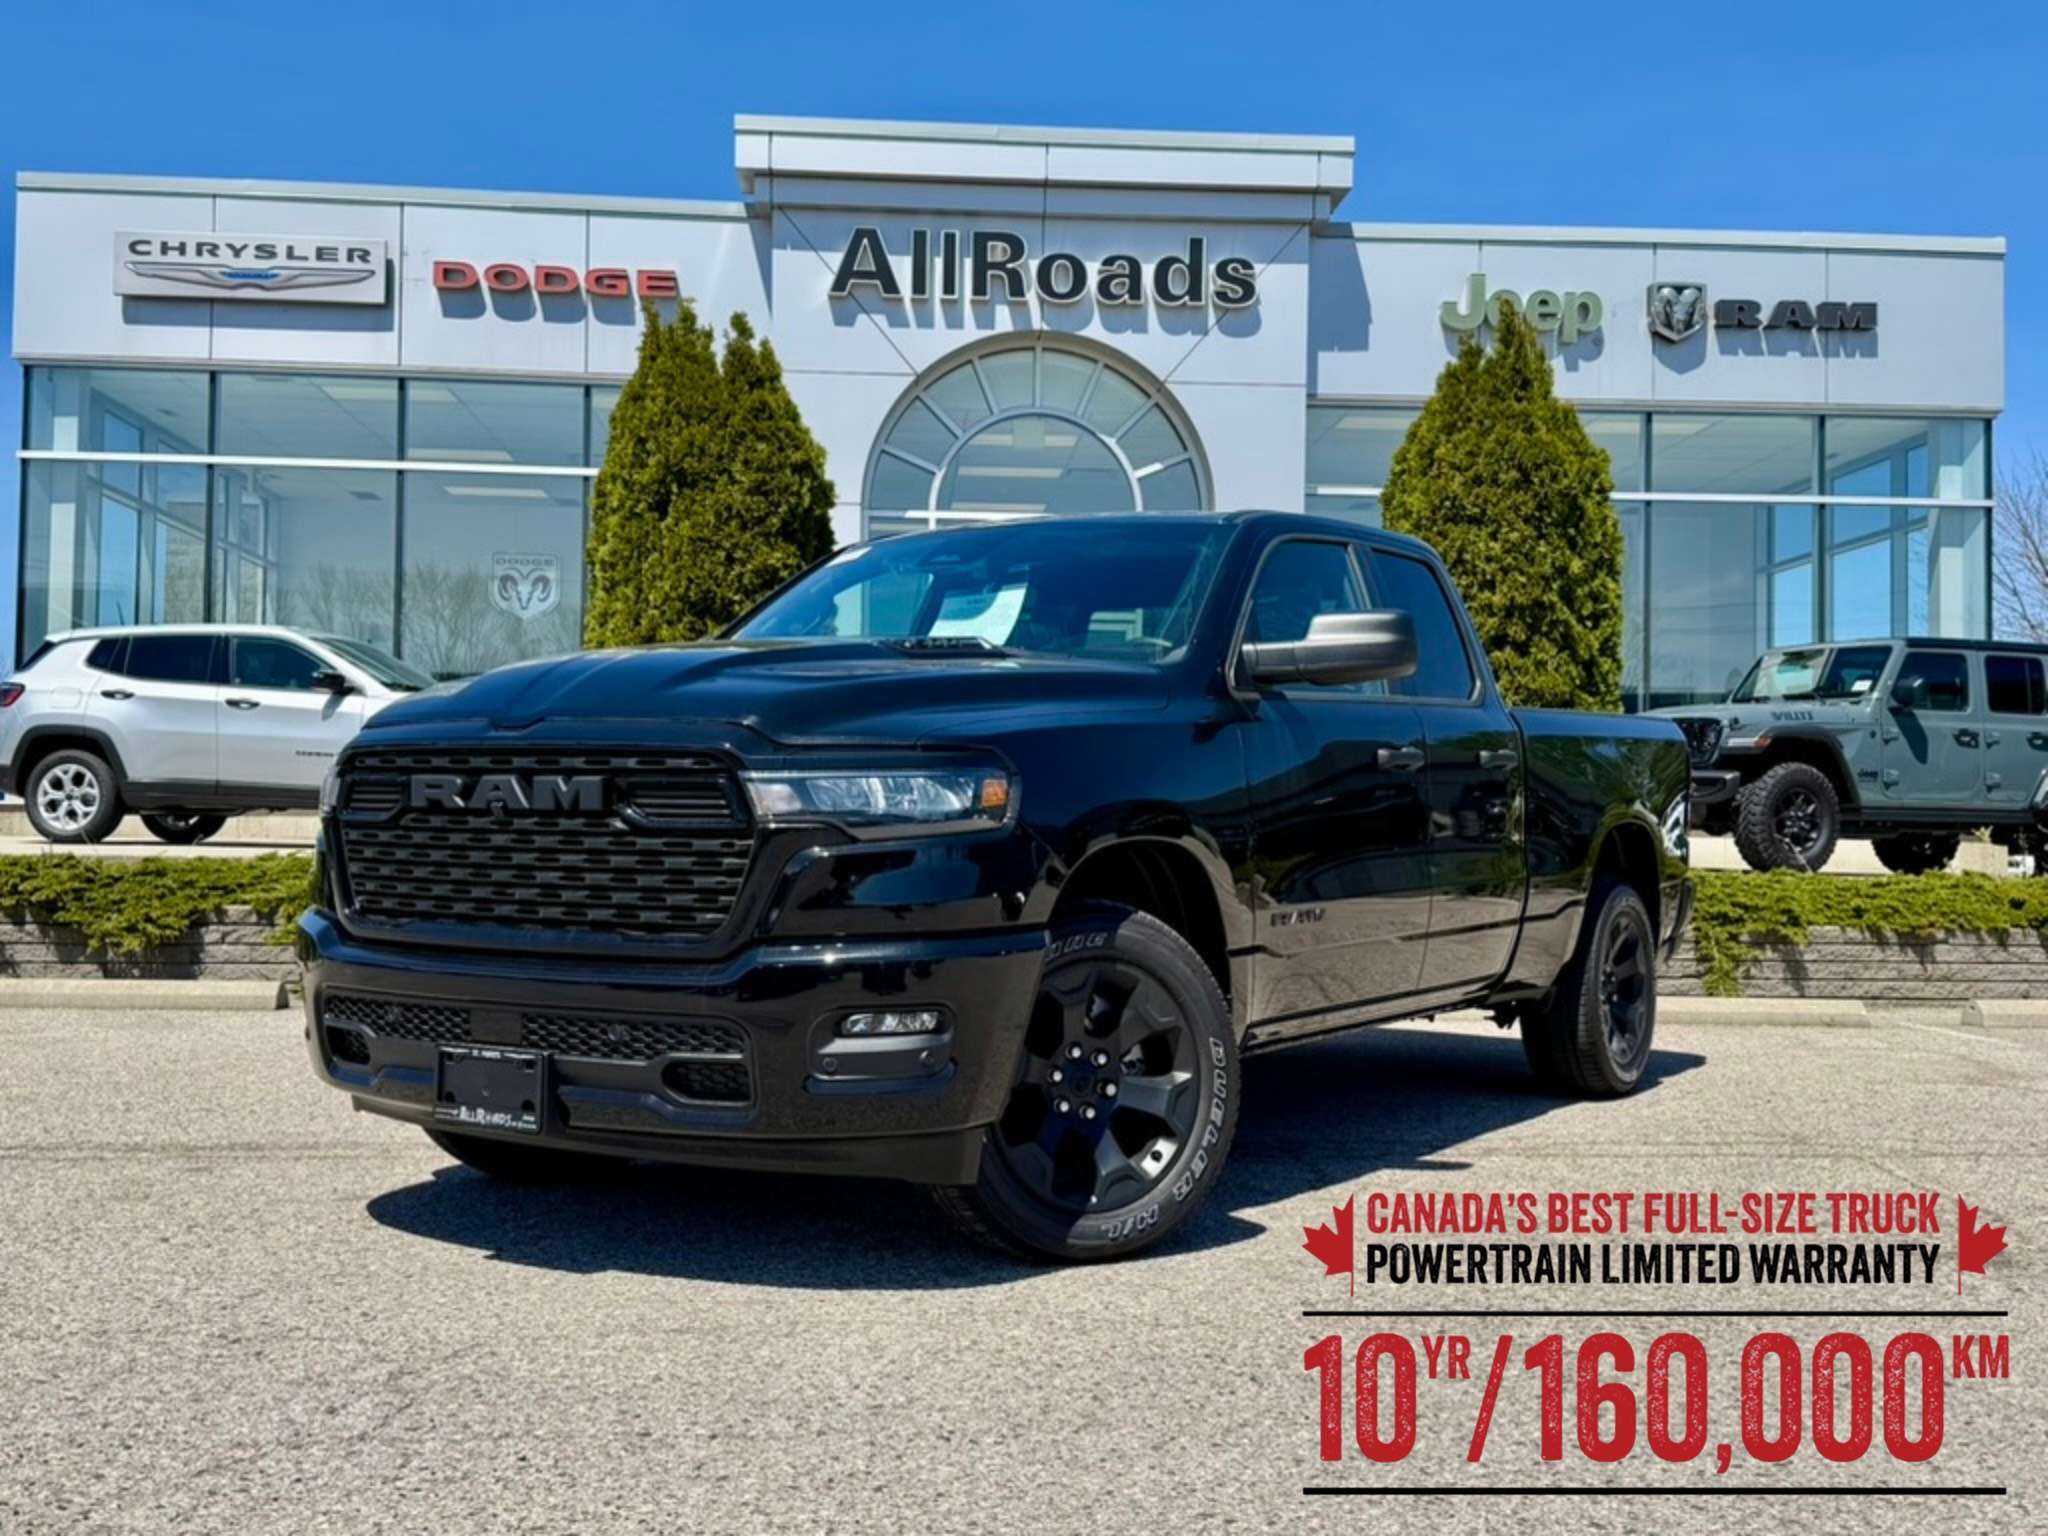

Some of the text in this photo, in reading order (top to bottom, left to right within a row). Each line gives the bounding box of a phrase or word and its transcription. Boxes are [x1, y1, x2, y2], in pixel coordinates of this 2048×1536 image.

[128, 239, 372, 263] CHRYSLER
[829, 226, 1257, 308] AllRoads
[434, 261, 678, 298] DODGE
[1440, 273, 1603, 344] Jeep
[1713, 299, 1878, 330] RAM
[496, 557, 555, 567] DODGE
[410, 774, 604, 811] RAM
[1172, 1036, 1227, 1201] DUELER
